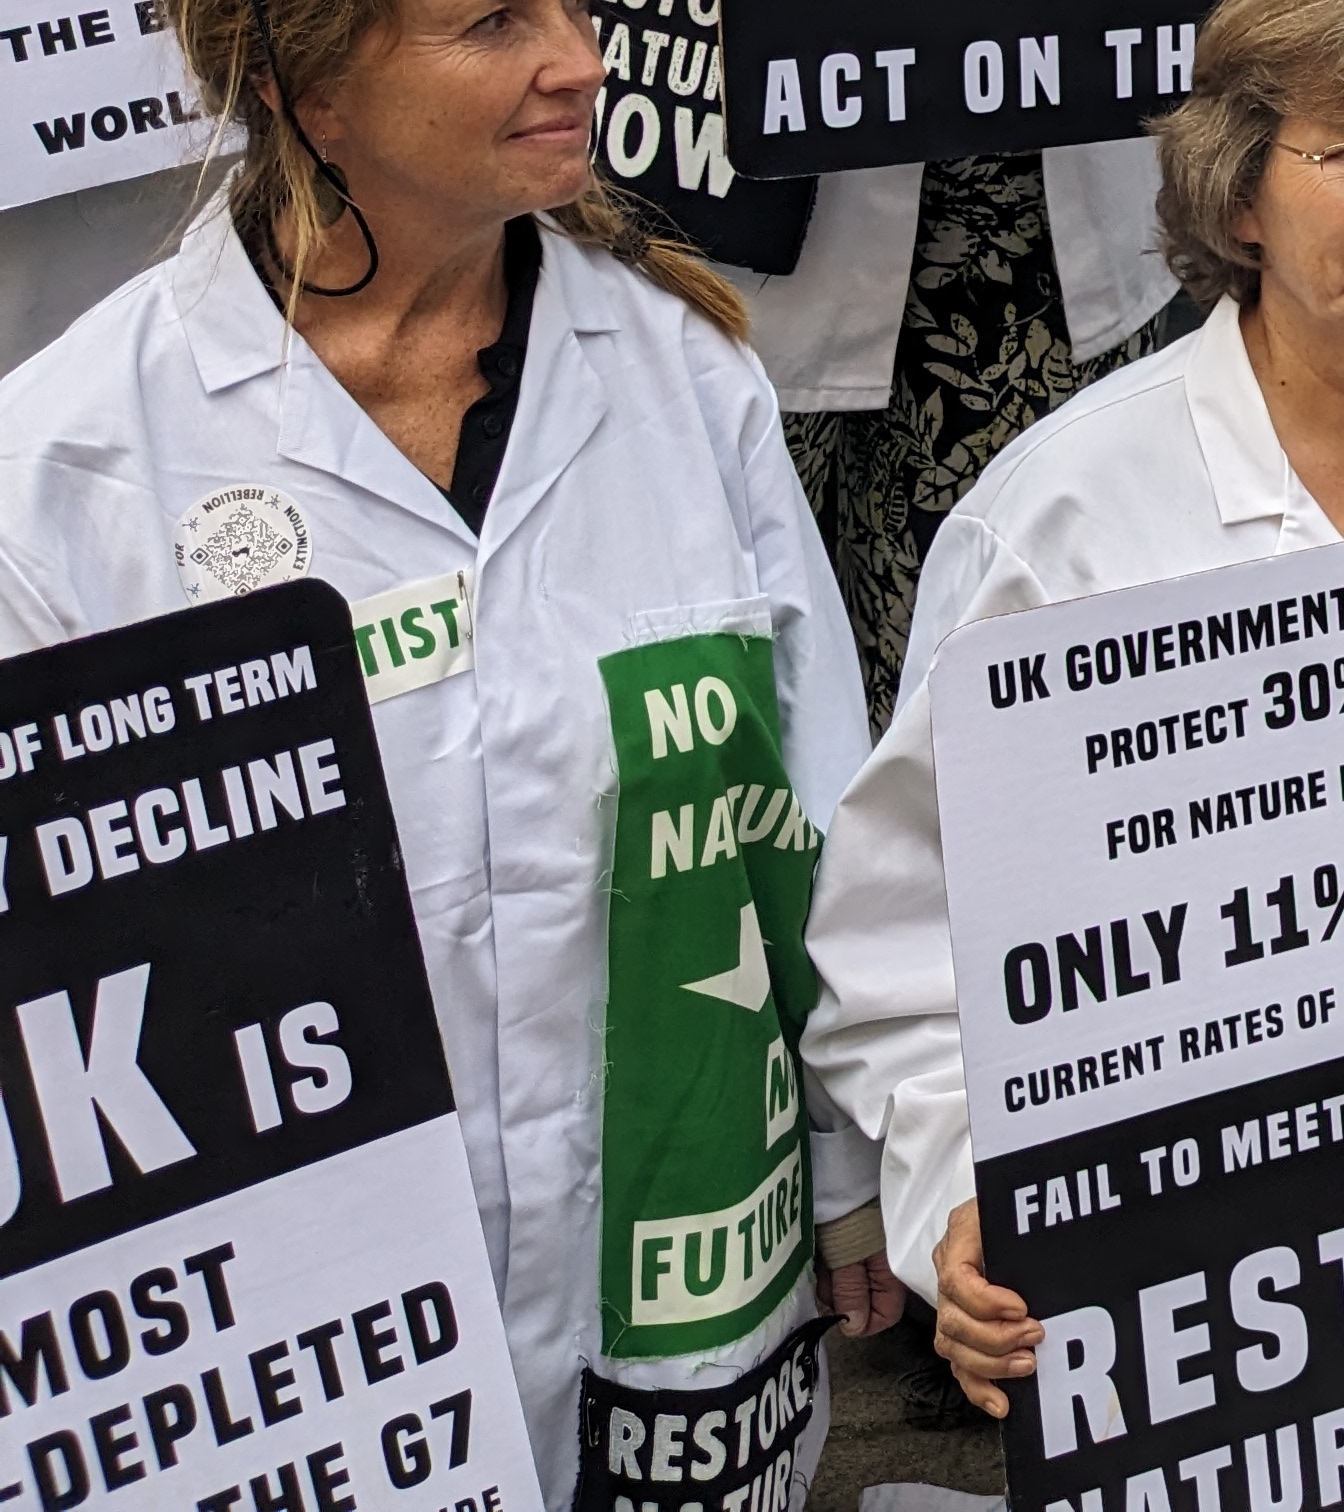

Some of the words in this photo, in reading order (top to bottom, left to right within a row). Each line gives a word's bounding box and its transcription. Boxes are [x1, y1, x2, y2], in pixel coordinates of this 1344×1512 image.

[202, 488, 264, 514] REBELLION
[284, 505, 308, 570] EXTINCTION
[175, 543, 185, 566] FOR
[56, 686, 176, 752] LONG
[184, 645, 317, 723] TERM
[643, 676, 737, 758] NO
[988, 654, 1051, 710] UK
[37, 738, 345, 898] DECLINE
[1003, 902, 1189, 1026] ONLY
[233, 1000, 353, 1136] IS
[1004, 1036, 1165, 1114] CURRENT
[1181, 1005, 1285, 1063] RATES
[1297, 994, 1338, 1028] OF
[1014, 1164, 1121, 1235] FAIL
[1141, 1138, 1201, 1196] TO
[608, 1341, 809, 1482] RESTORE
